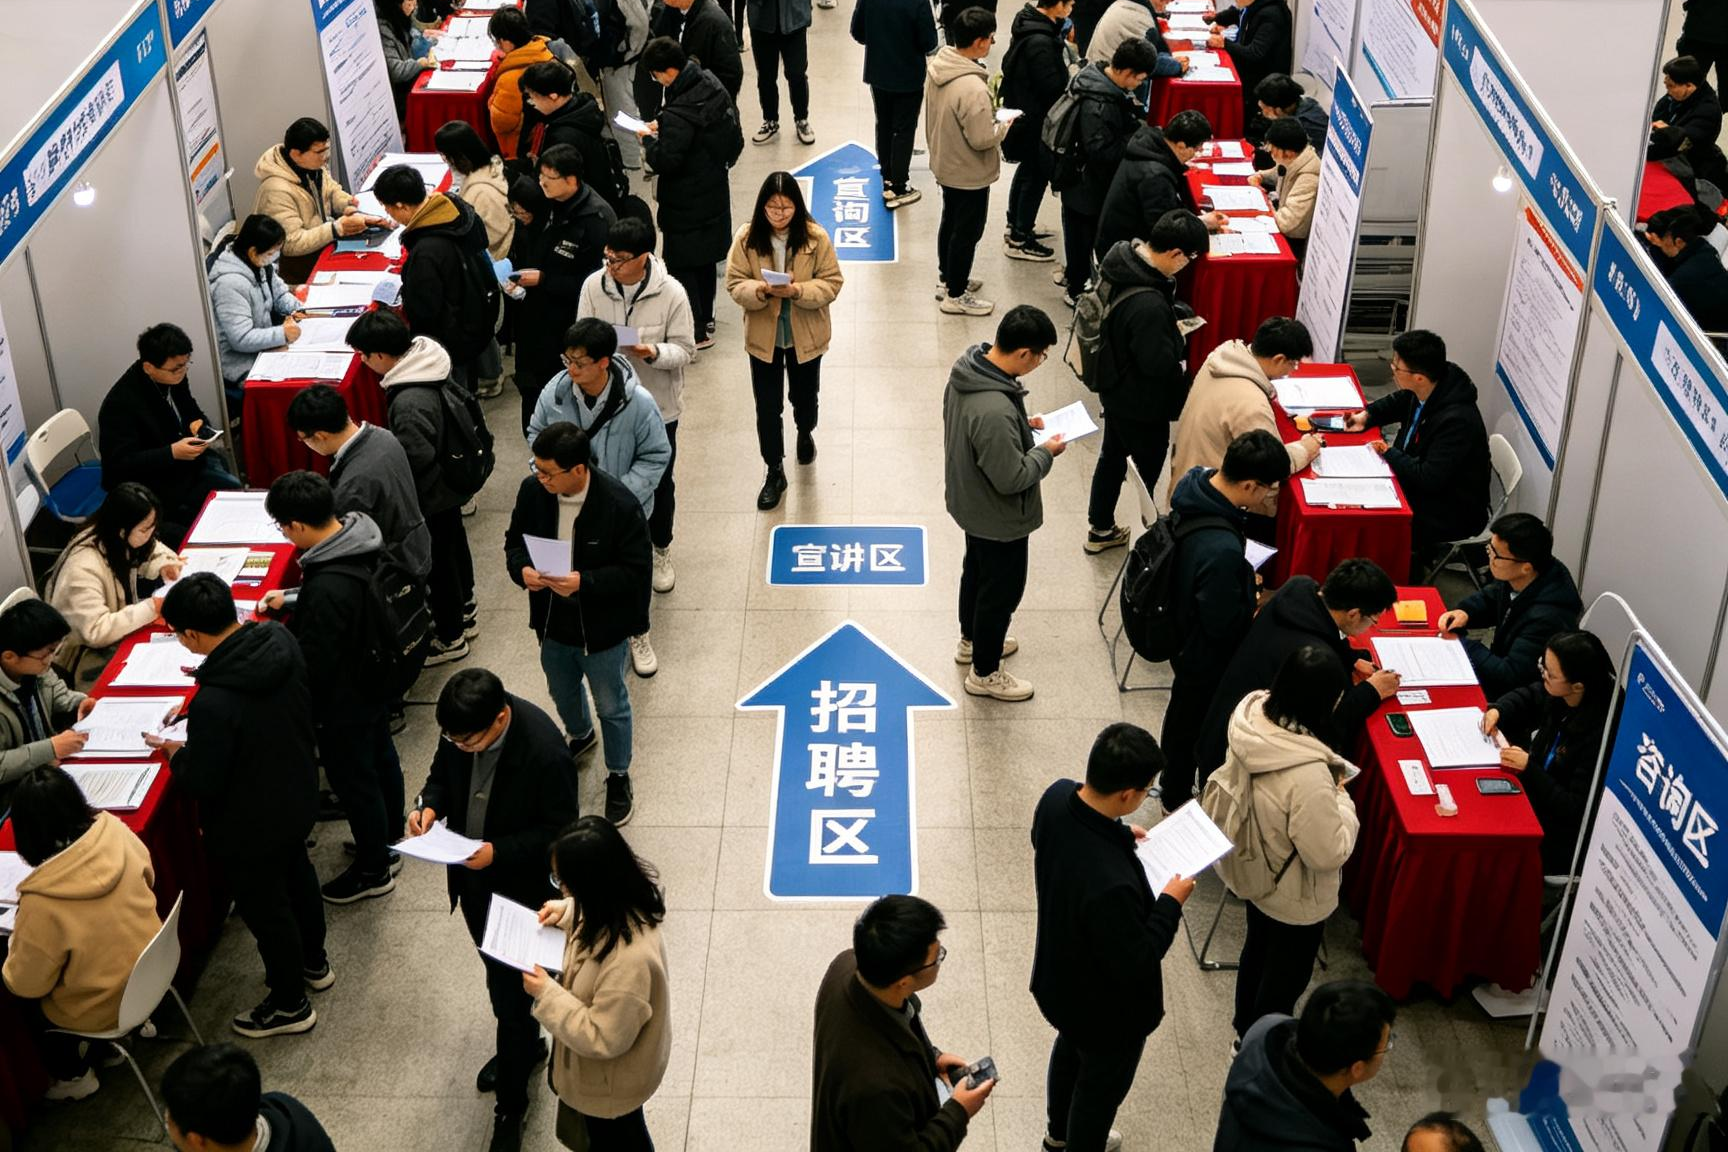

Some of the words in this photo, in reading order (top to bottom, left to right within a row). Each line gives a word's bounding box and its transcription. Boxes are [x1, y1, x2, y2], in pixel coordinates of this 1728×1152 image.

[791, 542, 906, 573] 宣讲区
[805, 680, 881, 864] 招聘区
[1636, 732, 1719, 869] 咨询区
